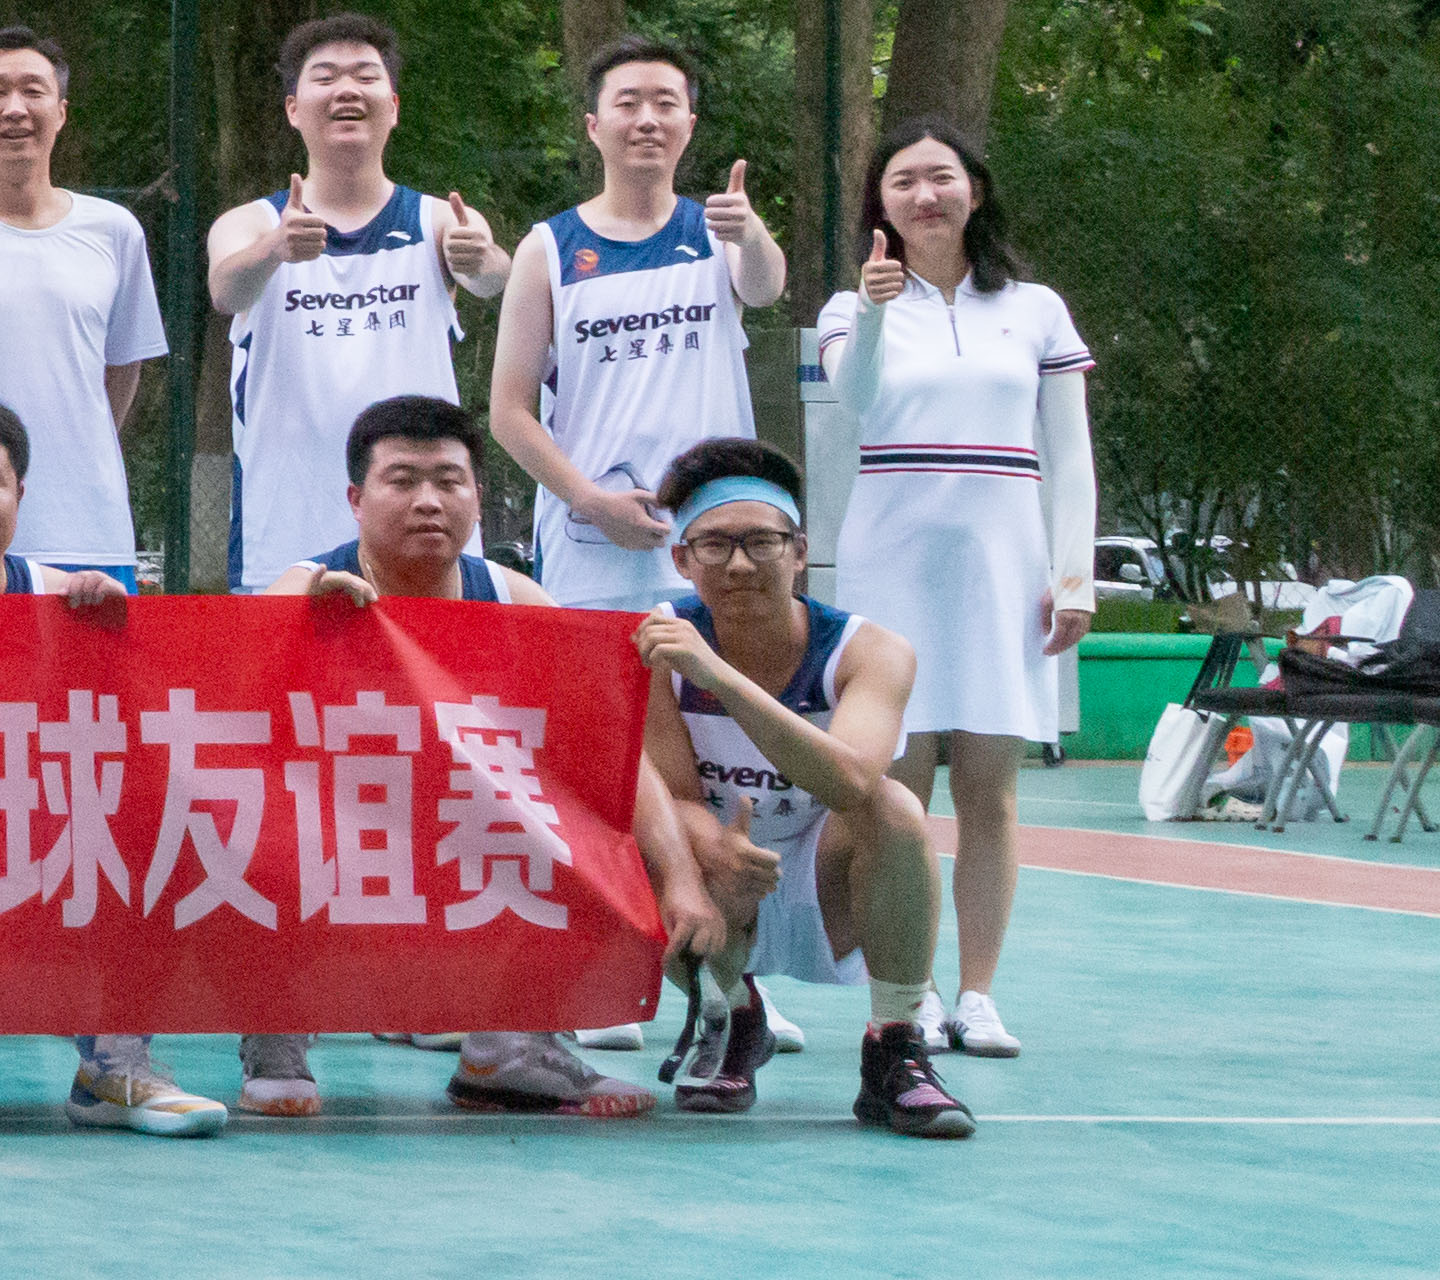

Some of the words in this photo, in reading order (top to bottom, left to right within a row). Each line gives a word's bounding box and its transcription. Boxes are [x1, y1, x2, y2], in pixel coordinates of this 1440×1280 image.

[285, 284, 420, 312] Sevenstar
[305, 309, 407, 337] 七星集团
[574, 303, 716, 344] Sevenstar
[599, 331, 700, 363] 七星集团
